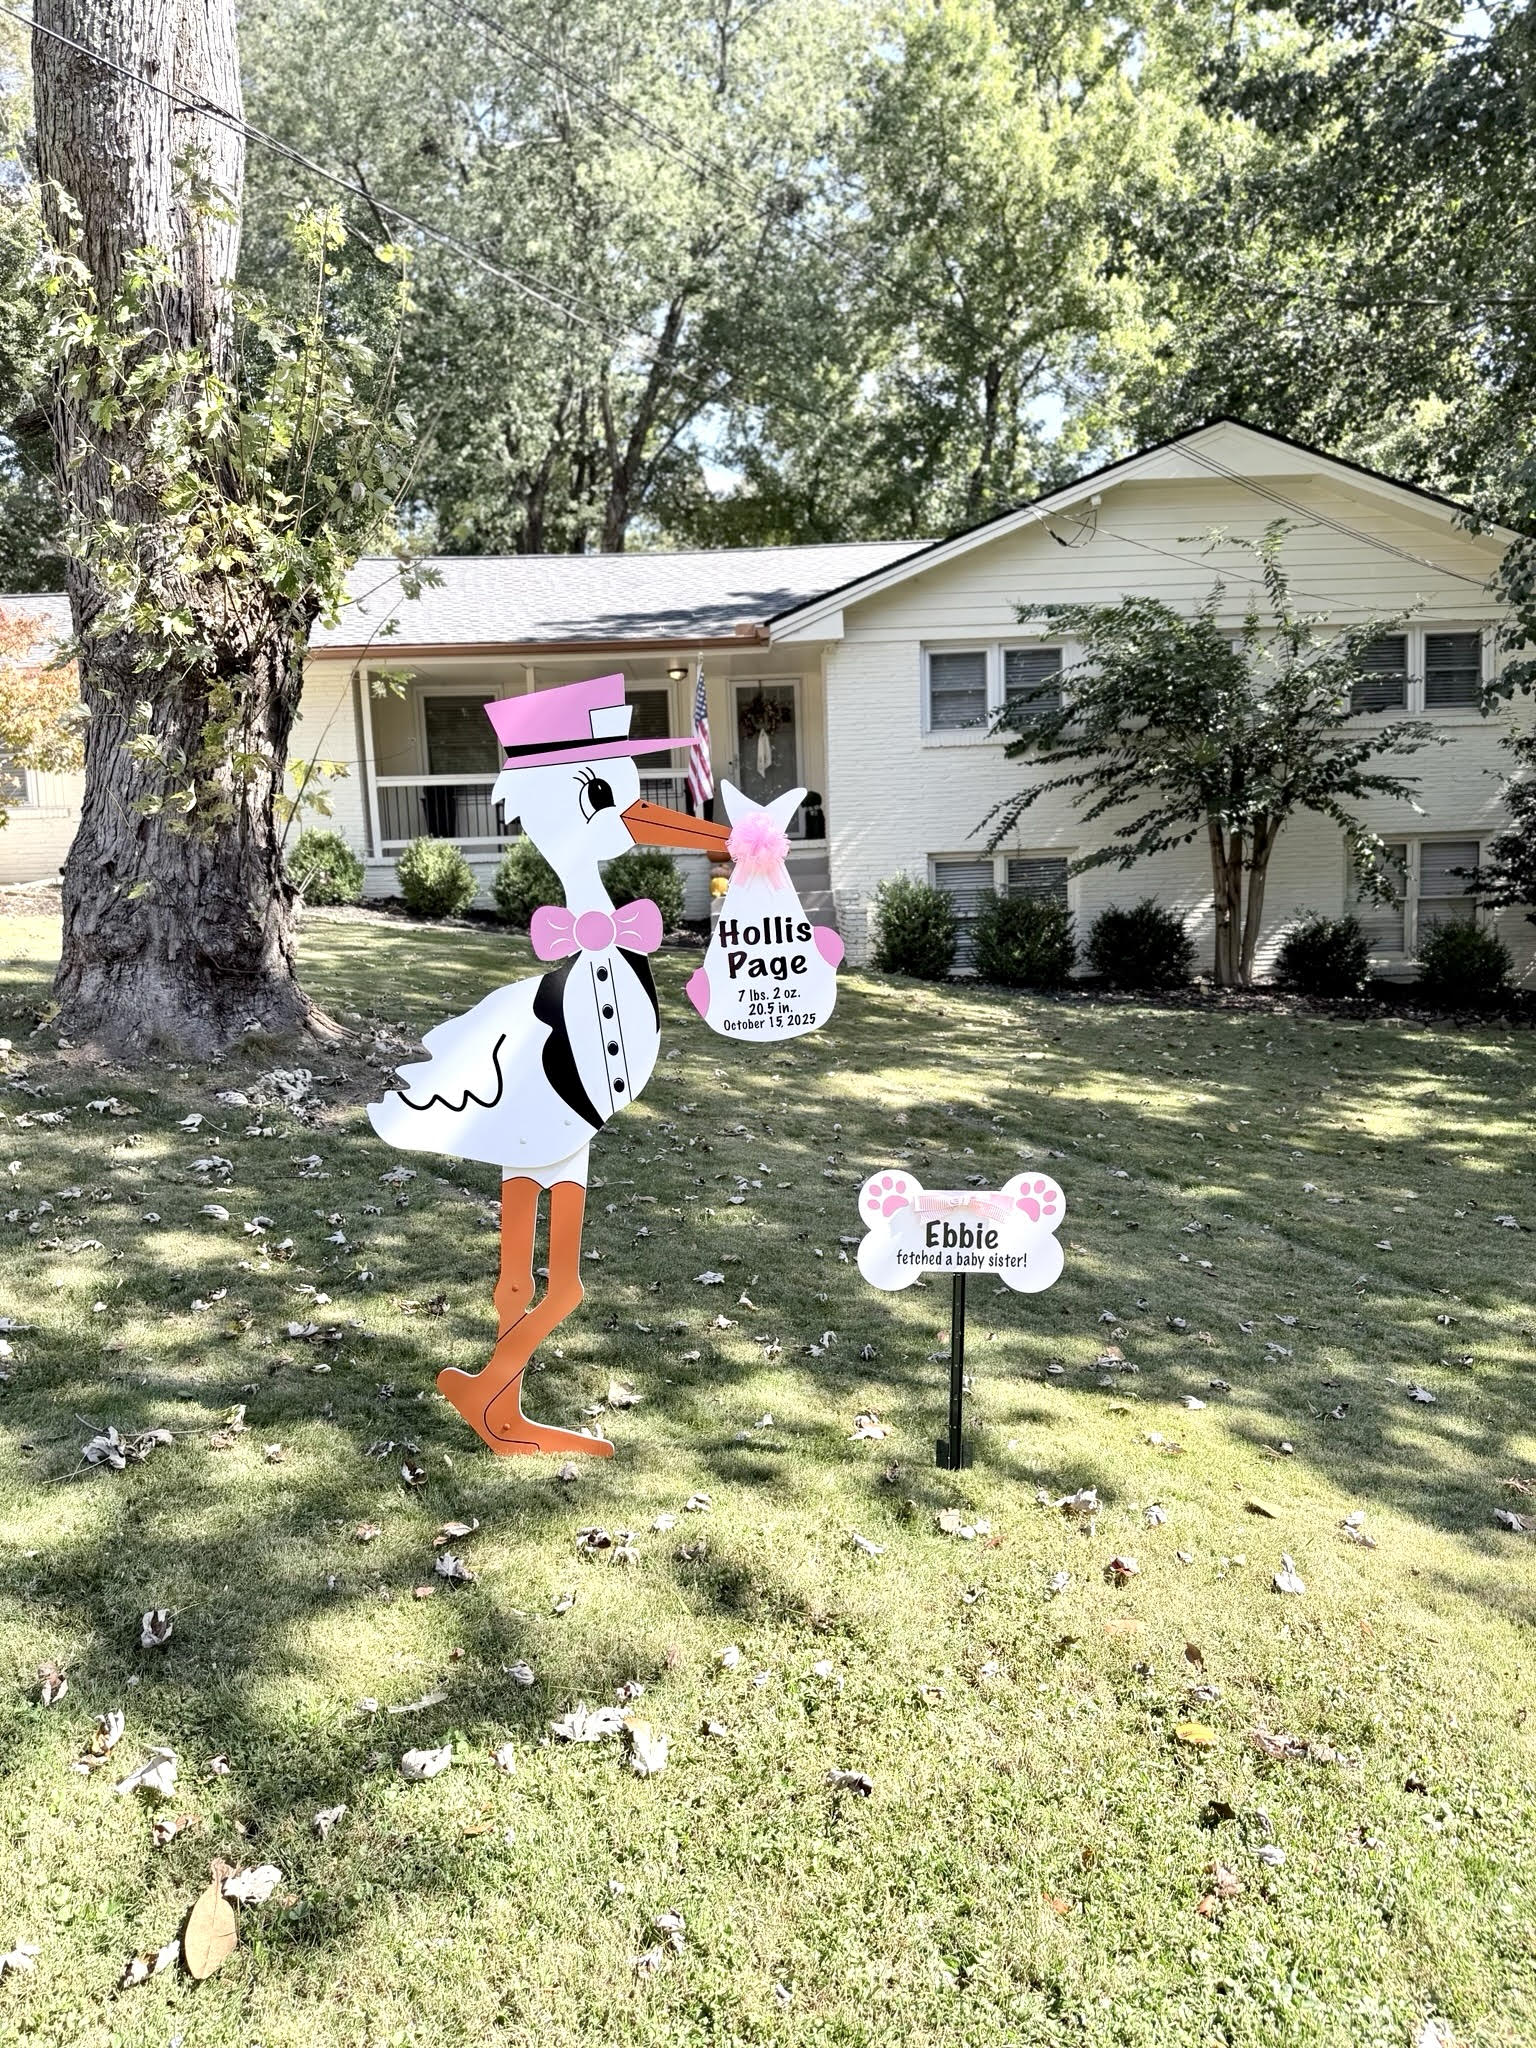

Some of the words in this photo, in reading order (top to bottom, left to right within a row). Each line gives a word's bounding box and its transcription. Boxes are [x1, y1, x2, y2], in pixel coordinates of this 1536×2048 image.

[719, 916, 812, 948] Hollis
[727, 951, 808, 980] Page
[737, 989, 746, 1002] 7
[749, 989, 770, 1002] lbs.
[773, 987, 781, 1000] 2
[784, 989, 801, 999] oz.
[749, 1002, 775, 1016] 20.5
[778, 1002, 793, 1013] in.
[724, 1018, 765, 1031] October
[769, 1016, 784, 1028] 15,
[787, 1013, 816, 1026] 2025
[926, 1220, 999, 1249] Ebbie
[896, 1249, 942, 1266] fetched
[945, 1254, 953, 1265] a
[956, 1252, 985, 1269] baby
[988, 1253, 1027, 1268] sister!
